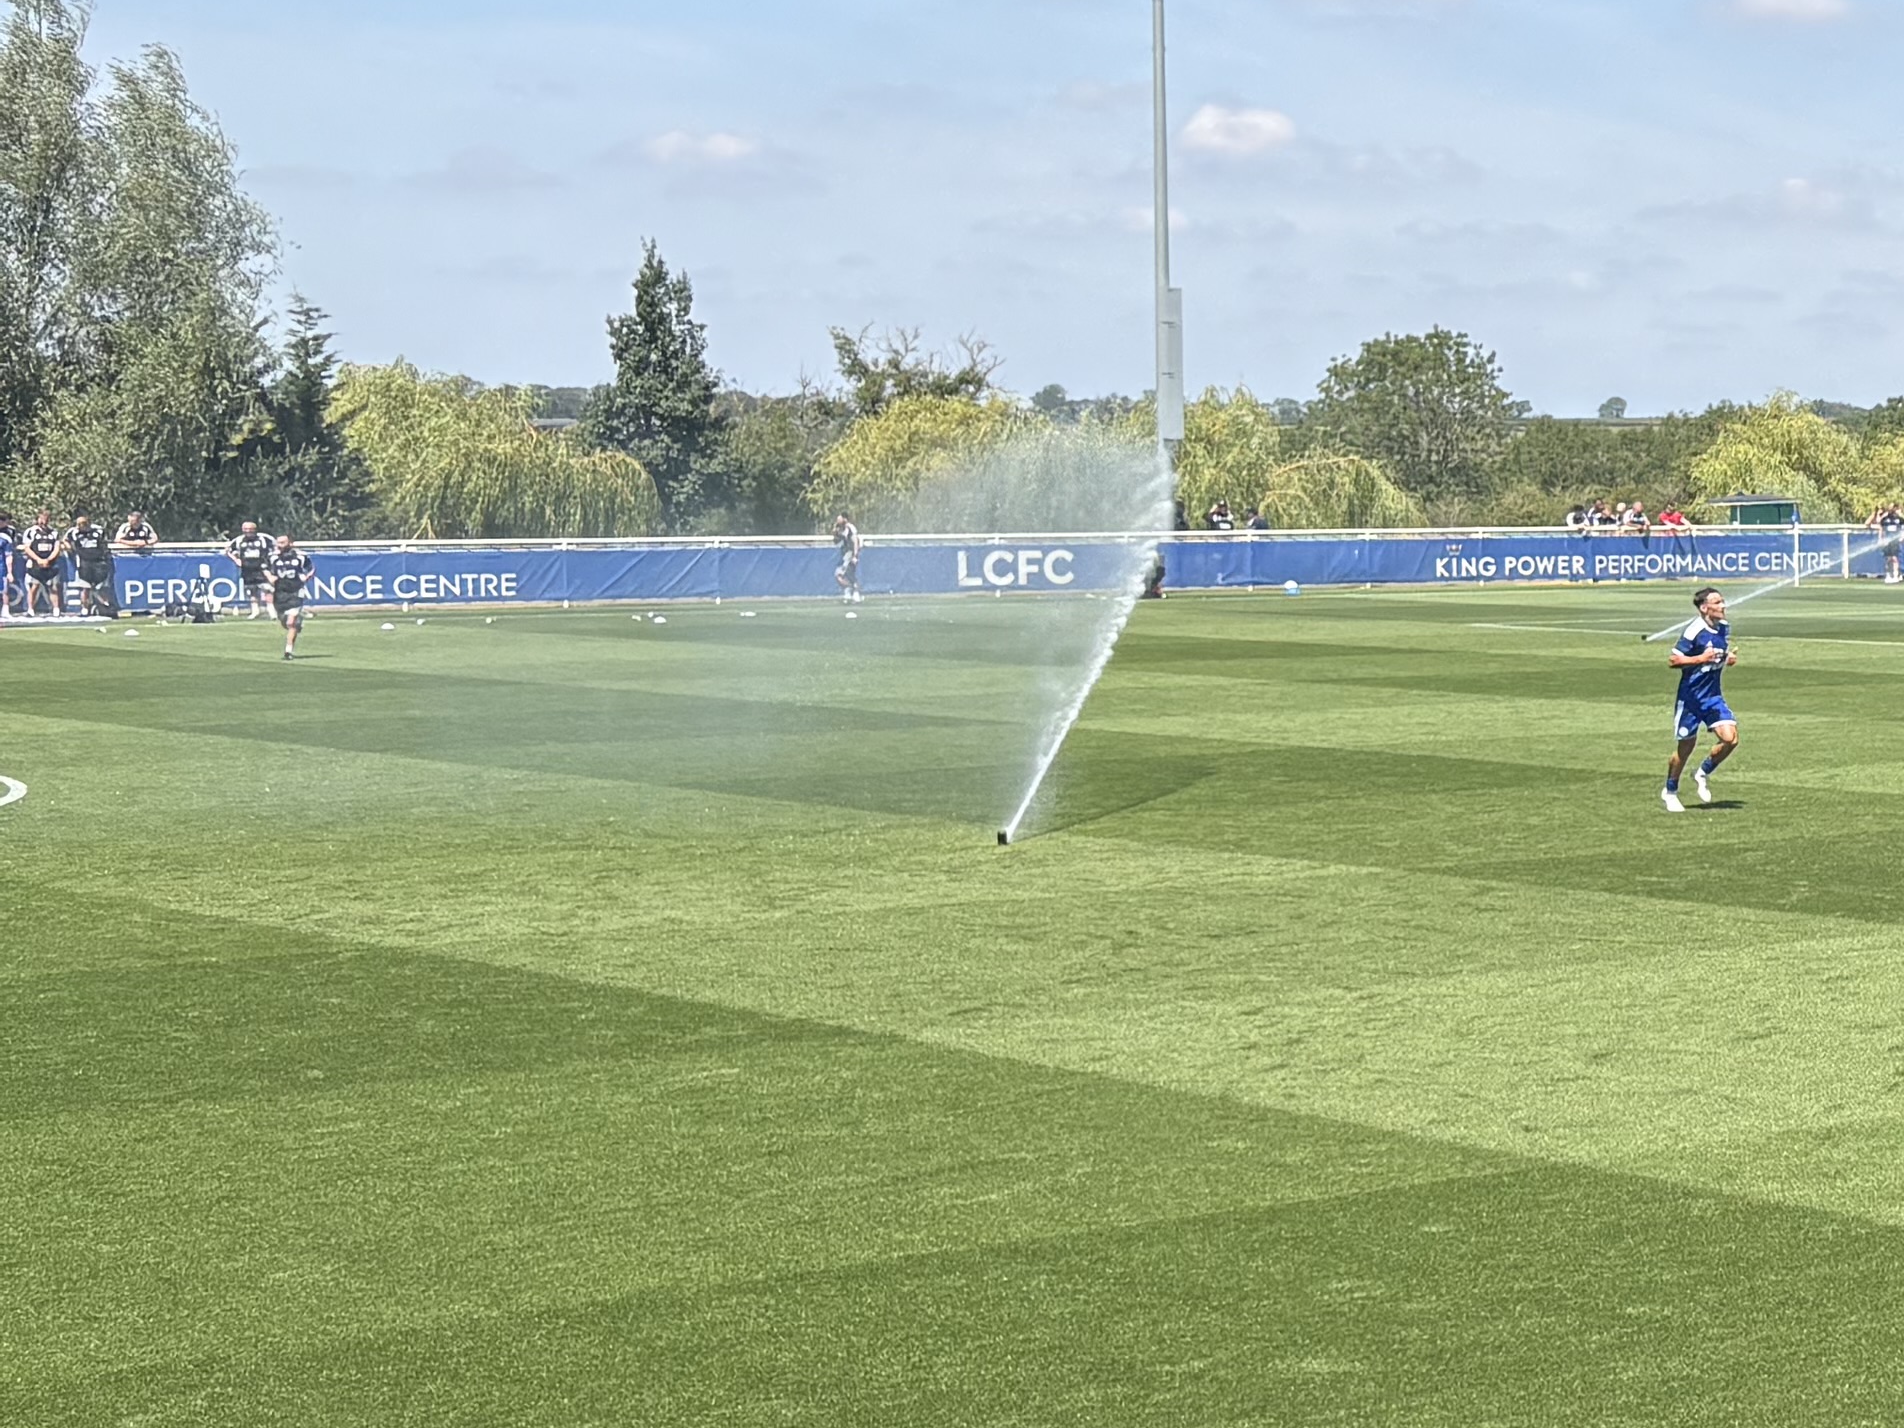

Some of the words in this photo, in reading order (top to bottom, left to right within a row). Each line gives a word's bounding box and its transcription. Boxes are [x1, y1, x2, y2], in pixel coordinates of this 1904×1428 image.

[957, 549, 1075, 586] LCFC
[1435, 554, 1497, 578] KING
[1504, 554, 1584, 575] POWER
[1595, 552, 1749, 575] PERFORMANCE
[1755, 551, 1831, 572] CENTRE
[393, 573, 518, 599] CENTRE
